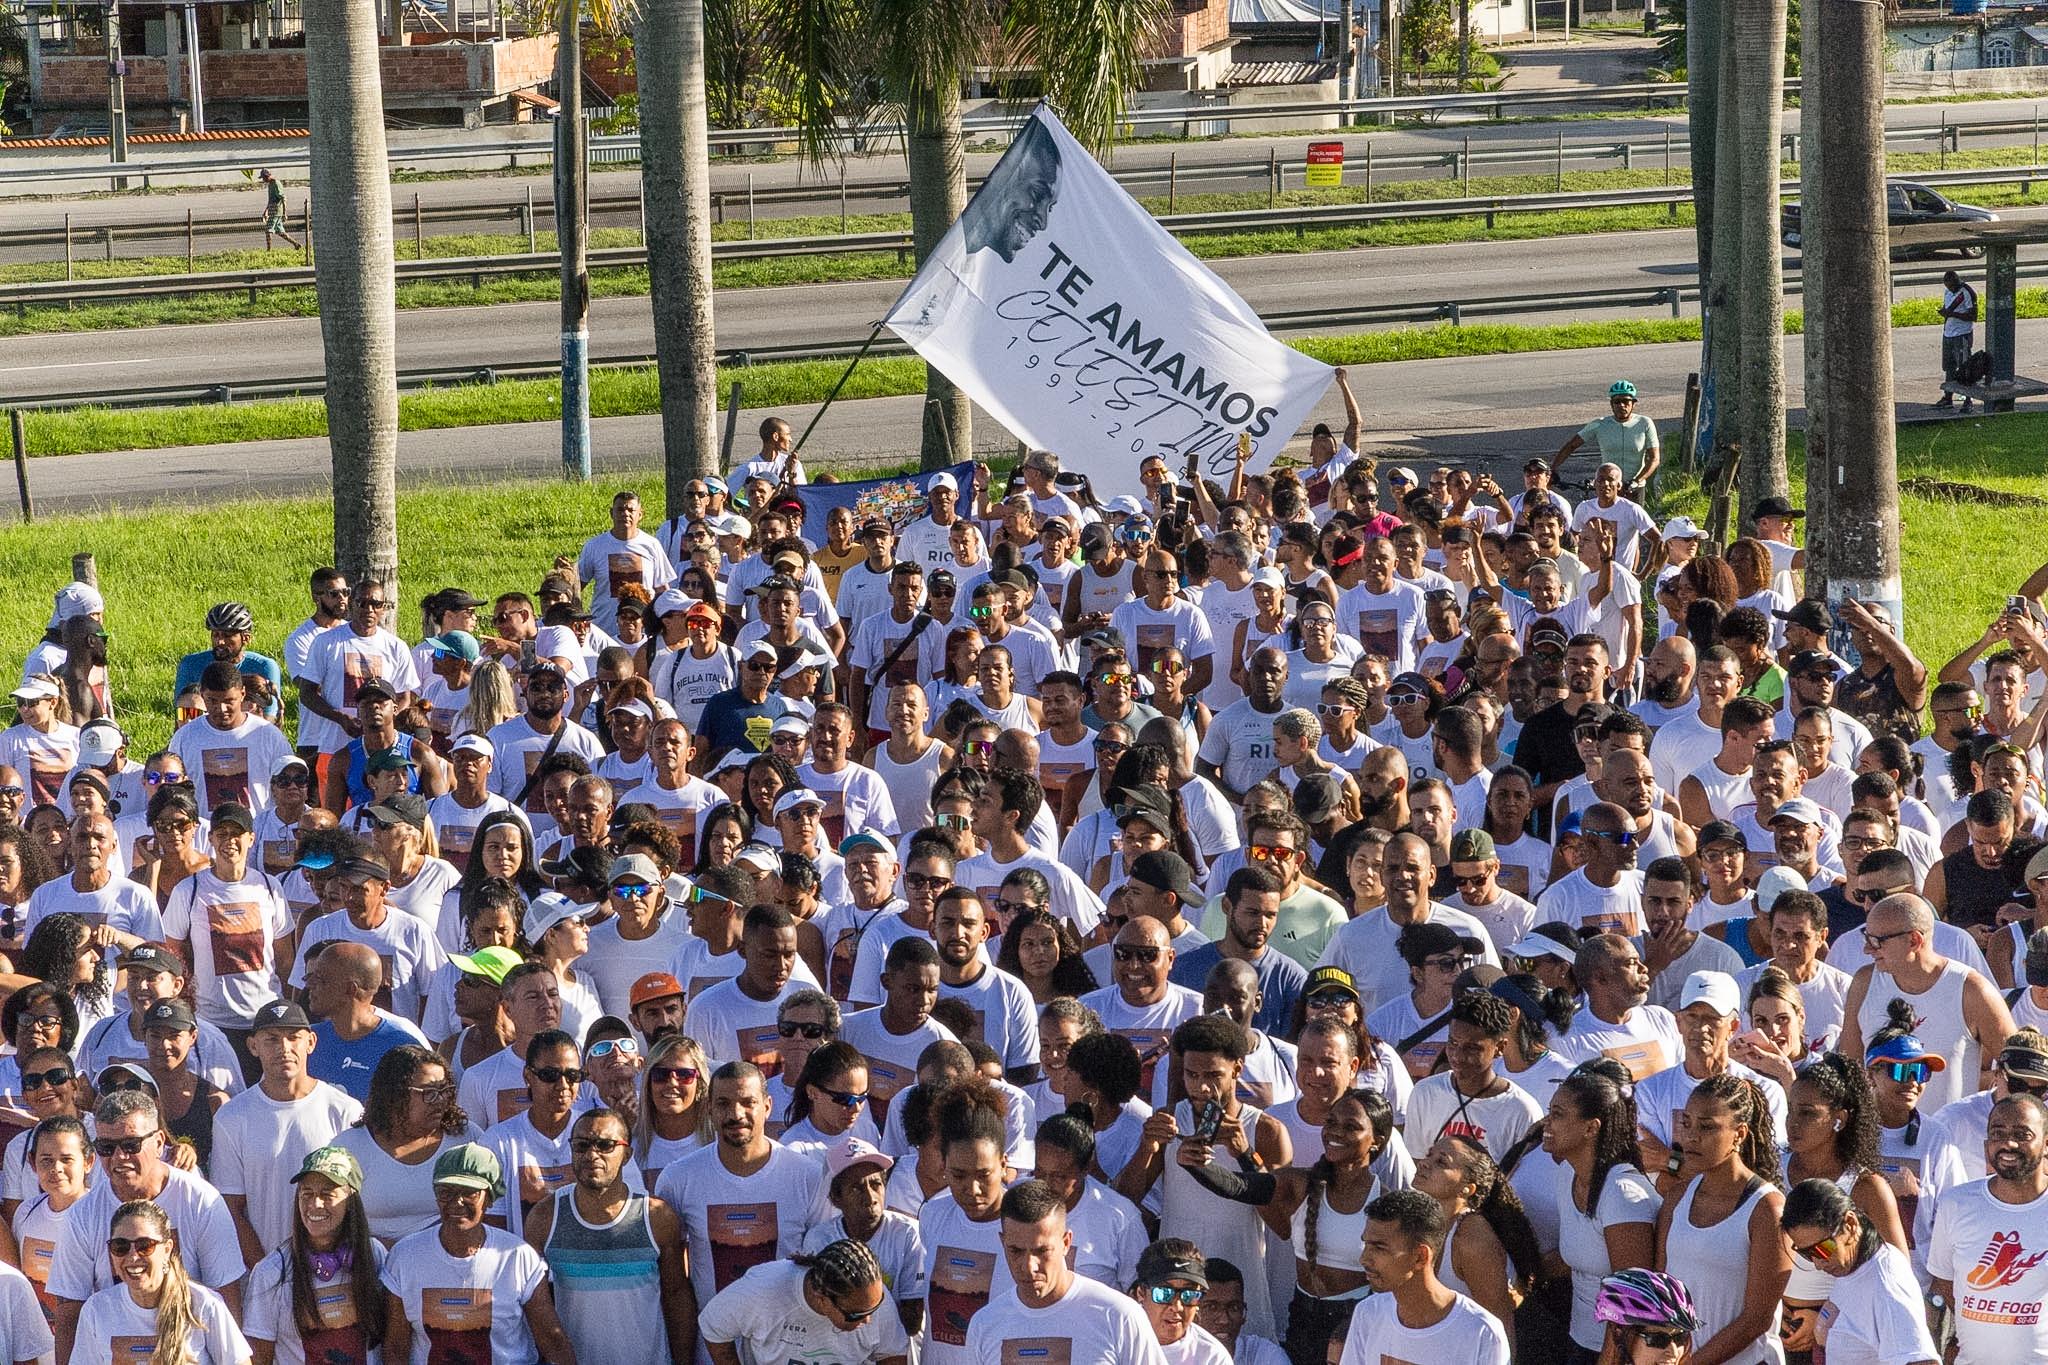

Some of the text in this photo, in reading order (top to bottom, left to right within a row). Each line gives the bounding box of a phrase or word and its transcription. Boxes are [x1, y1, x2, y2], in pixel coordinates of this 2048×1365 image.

[1038, 242, 1279, 438] TE AMAMOS
[928, 551, 954, 562] RIO
[688, 686, 718, 697] FILA
[1250, 744, 1276, 758] RI
[1315, 968, 1352, 986] NIRVANA
[1963, 1295, 2042, 1314] PÉ DE FOGO
[783, 1323, 807, 1333] VERA
